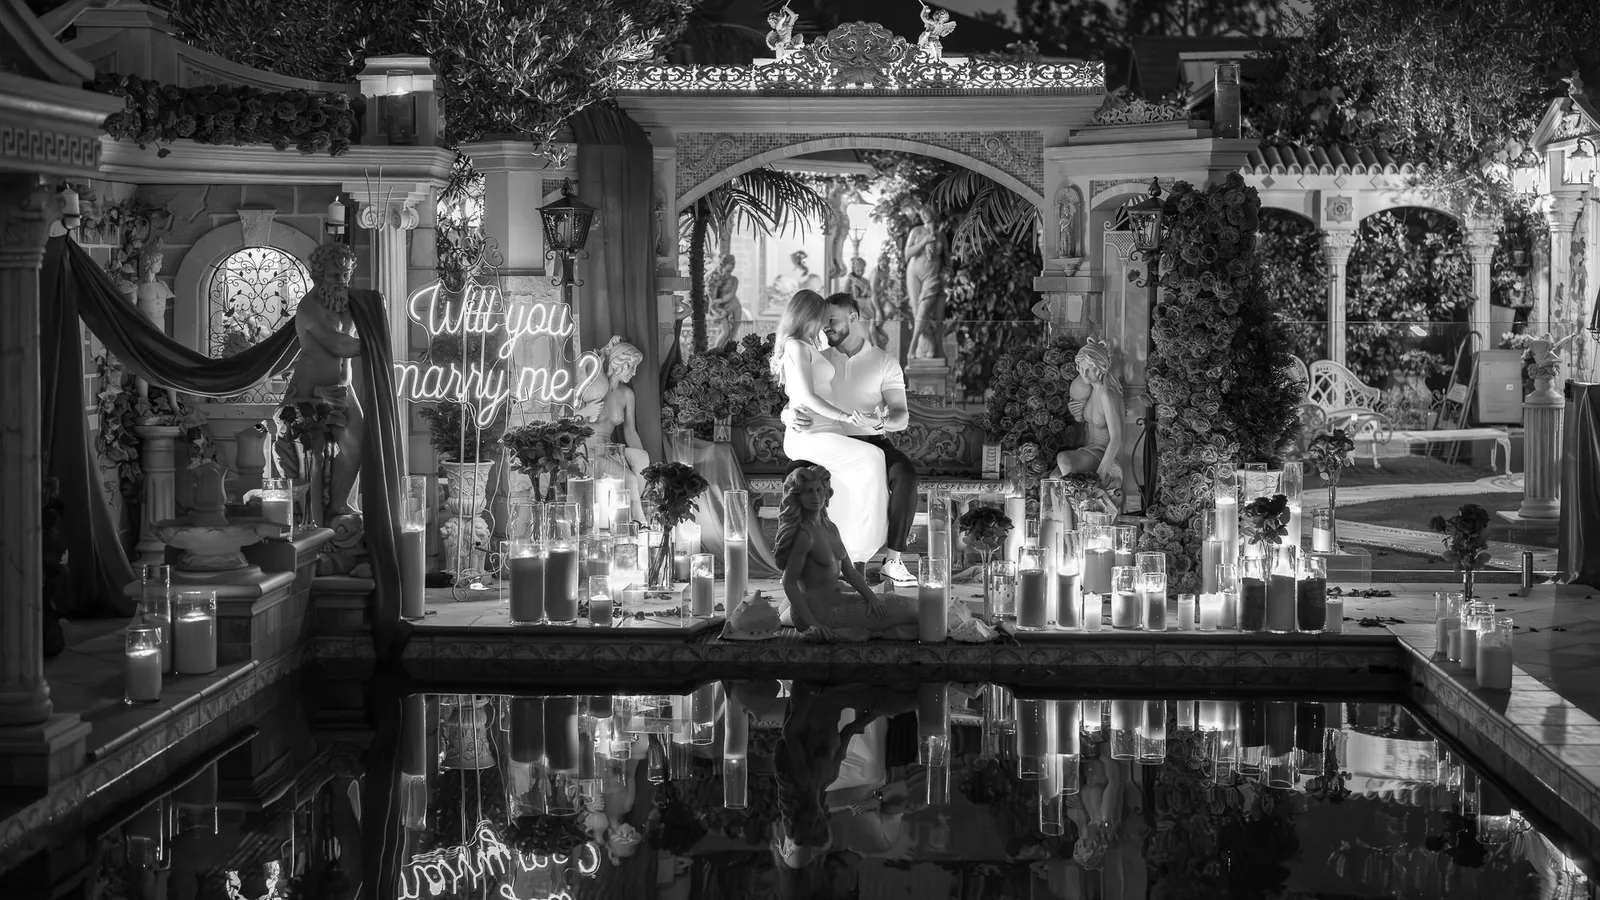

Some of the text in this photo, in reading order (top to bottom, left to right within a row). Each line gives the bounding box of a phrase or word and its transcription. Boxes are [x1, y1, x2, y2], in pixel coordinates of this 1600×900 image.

[410, 282, 574, 359] Will you
[393, 354, 599, 426] marry me?
